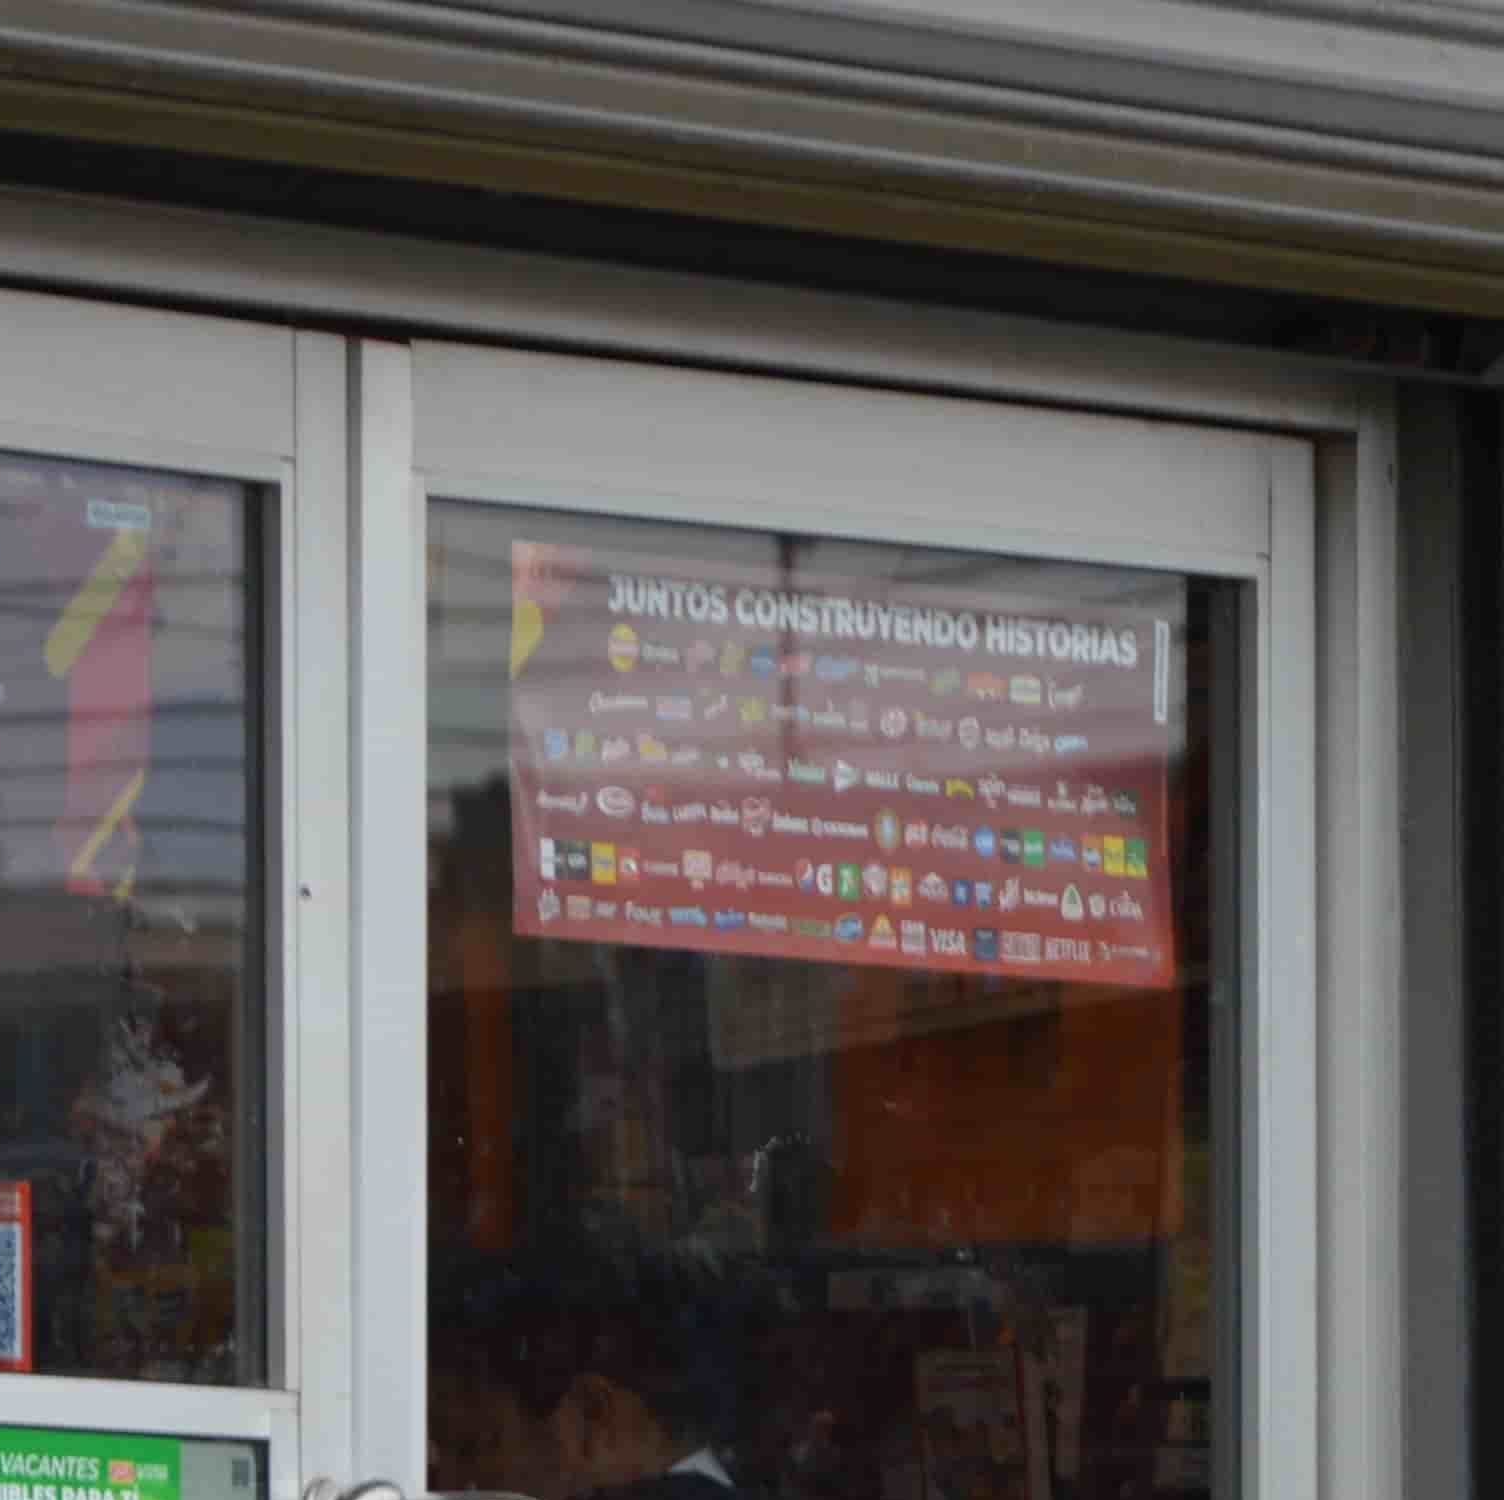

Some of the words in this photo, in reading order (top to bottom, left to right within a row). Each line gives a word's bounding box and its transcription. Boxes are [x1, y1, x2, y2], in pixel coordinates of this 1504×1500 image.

[608, 575, 729, 625] JUNTOS
[735, 589, 978, 650] CONSTRUYENDO
[986, 615, 1137, 667] HISTORIAS
[0, 1451, 101, 1481] VACANTES
